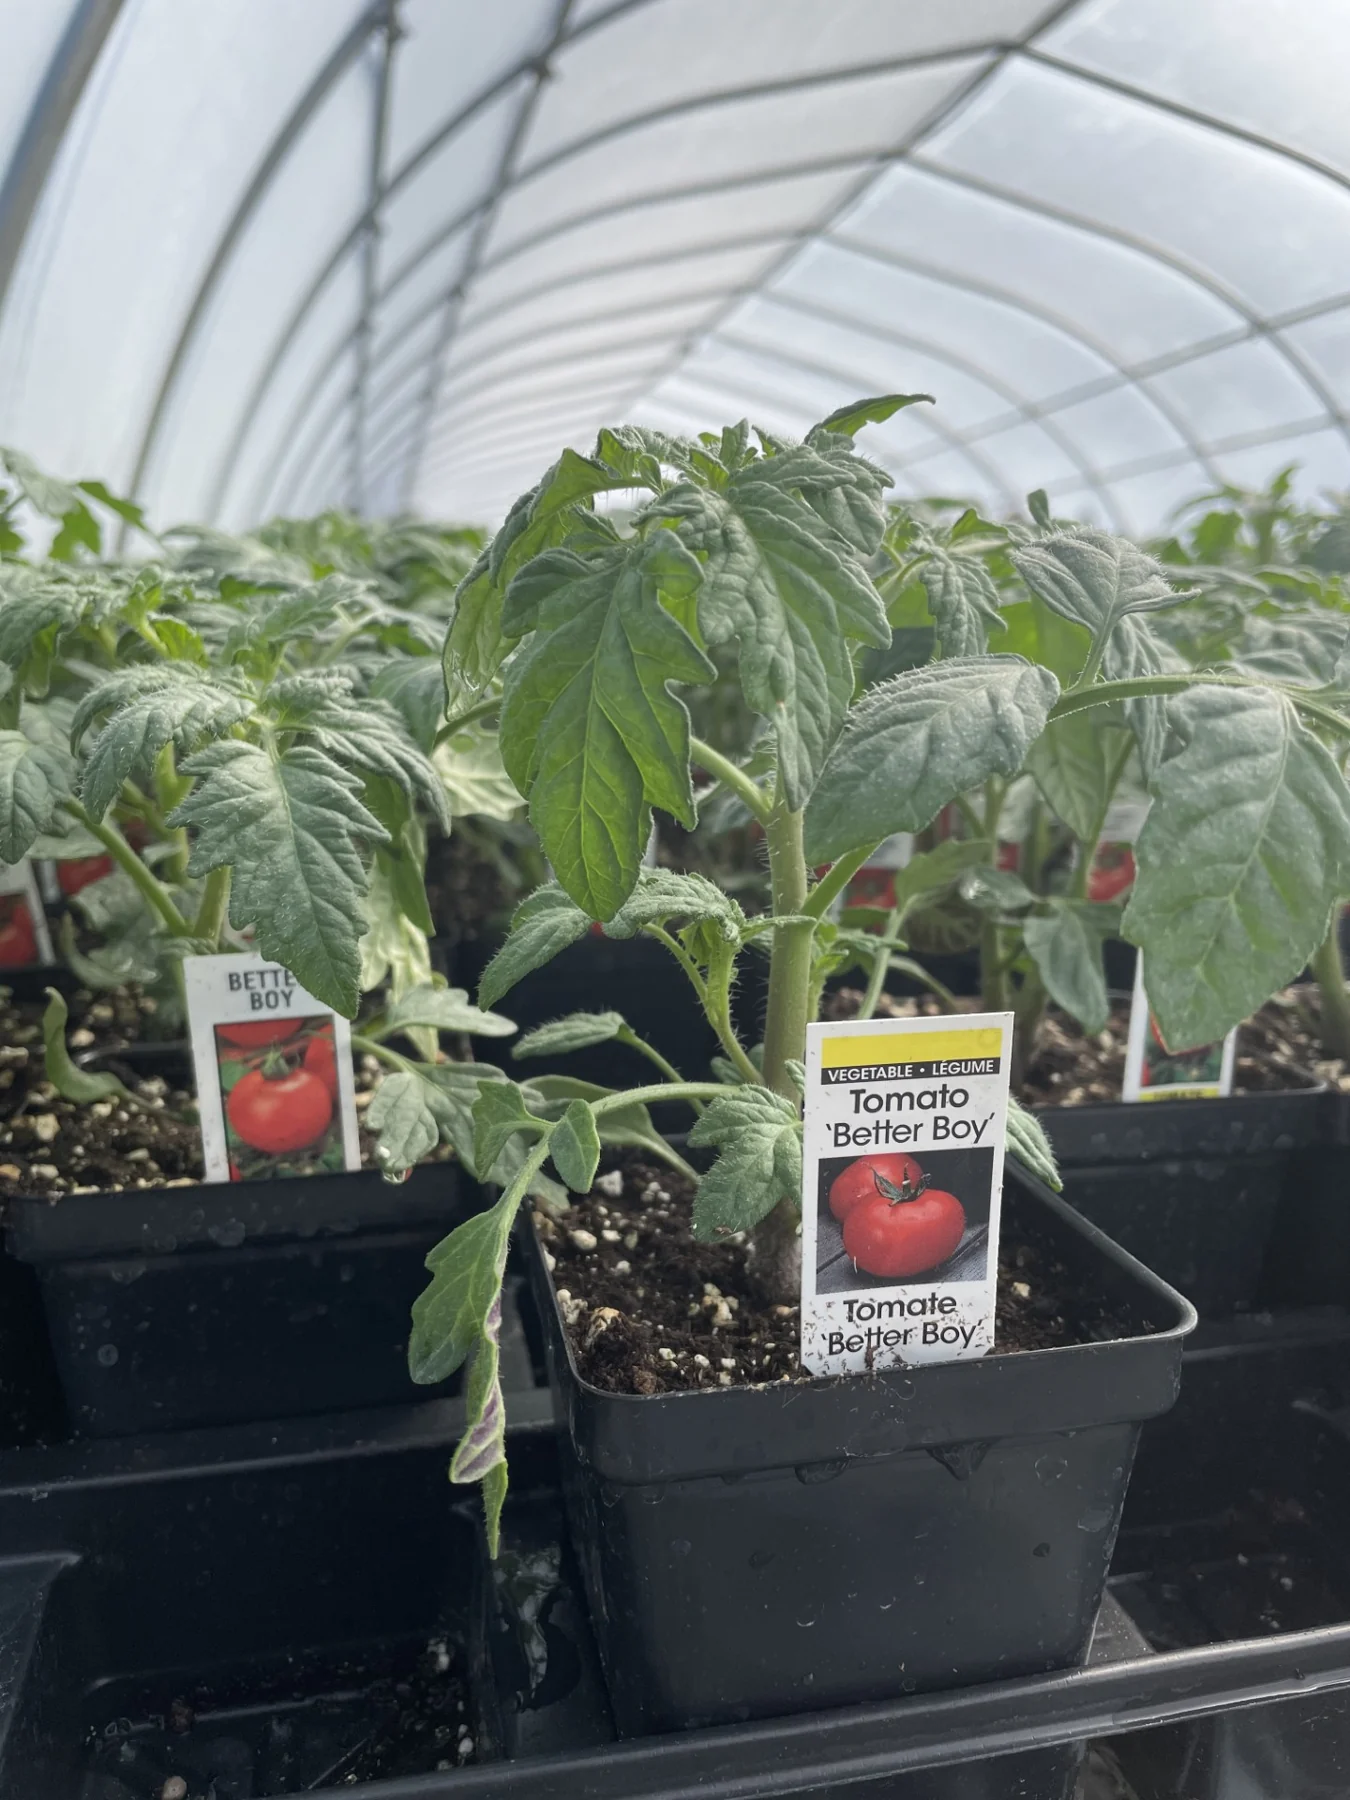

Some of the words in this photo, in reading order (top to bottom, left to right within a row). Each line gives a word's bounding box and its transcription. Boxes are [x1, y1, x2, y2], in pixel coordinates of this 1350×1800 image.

[228, 968, 297, 992] BETTE
[250, 989, 294, 1011] BOY
[827, 1065, 913, 1082] VEGETABLE
[932, 1060, 994, 1076] LÉGUME
[849, 1083, 970, 1114] Tomato
[825, 1119, 924, 1148] 'Better
[932, 1112, 995, 1144] Boy'
[843, 1292, 957, 1322] Tomate
